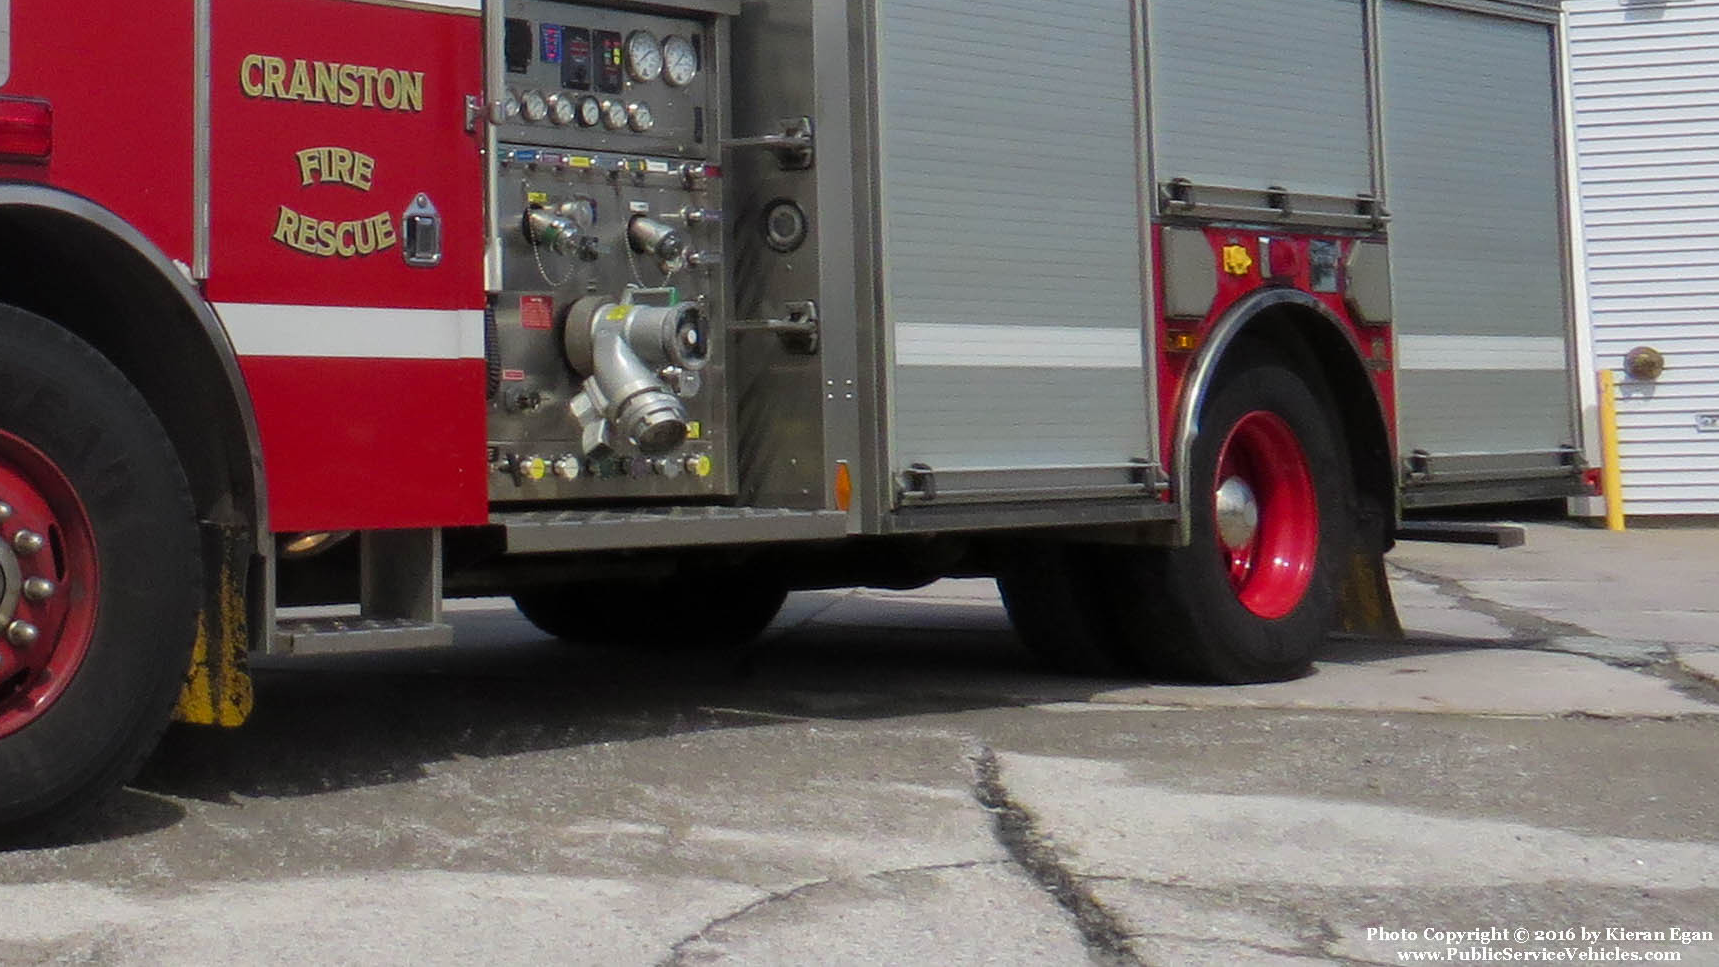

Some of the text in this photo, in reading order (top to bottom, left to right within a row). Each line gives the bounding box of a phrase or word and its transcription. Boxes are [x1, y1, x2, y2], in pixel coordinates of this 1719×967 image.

[240, 53, 425, 112] CRANSTON
[295, 146, 376, 192] FIRE
[272, 205, 397, 258] RESCUE
